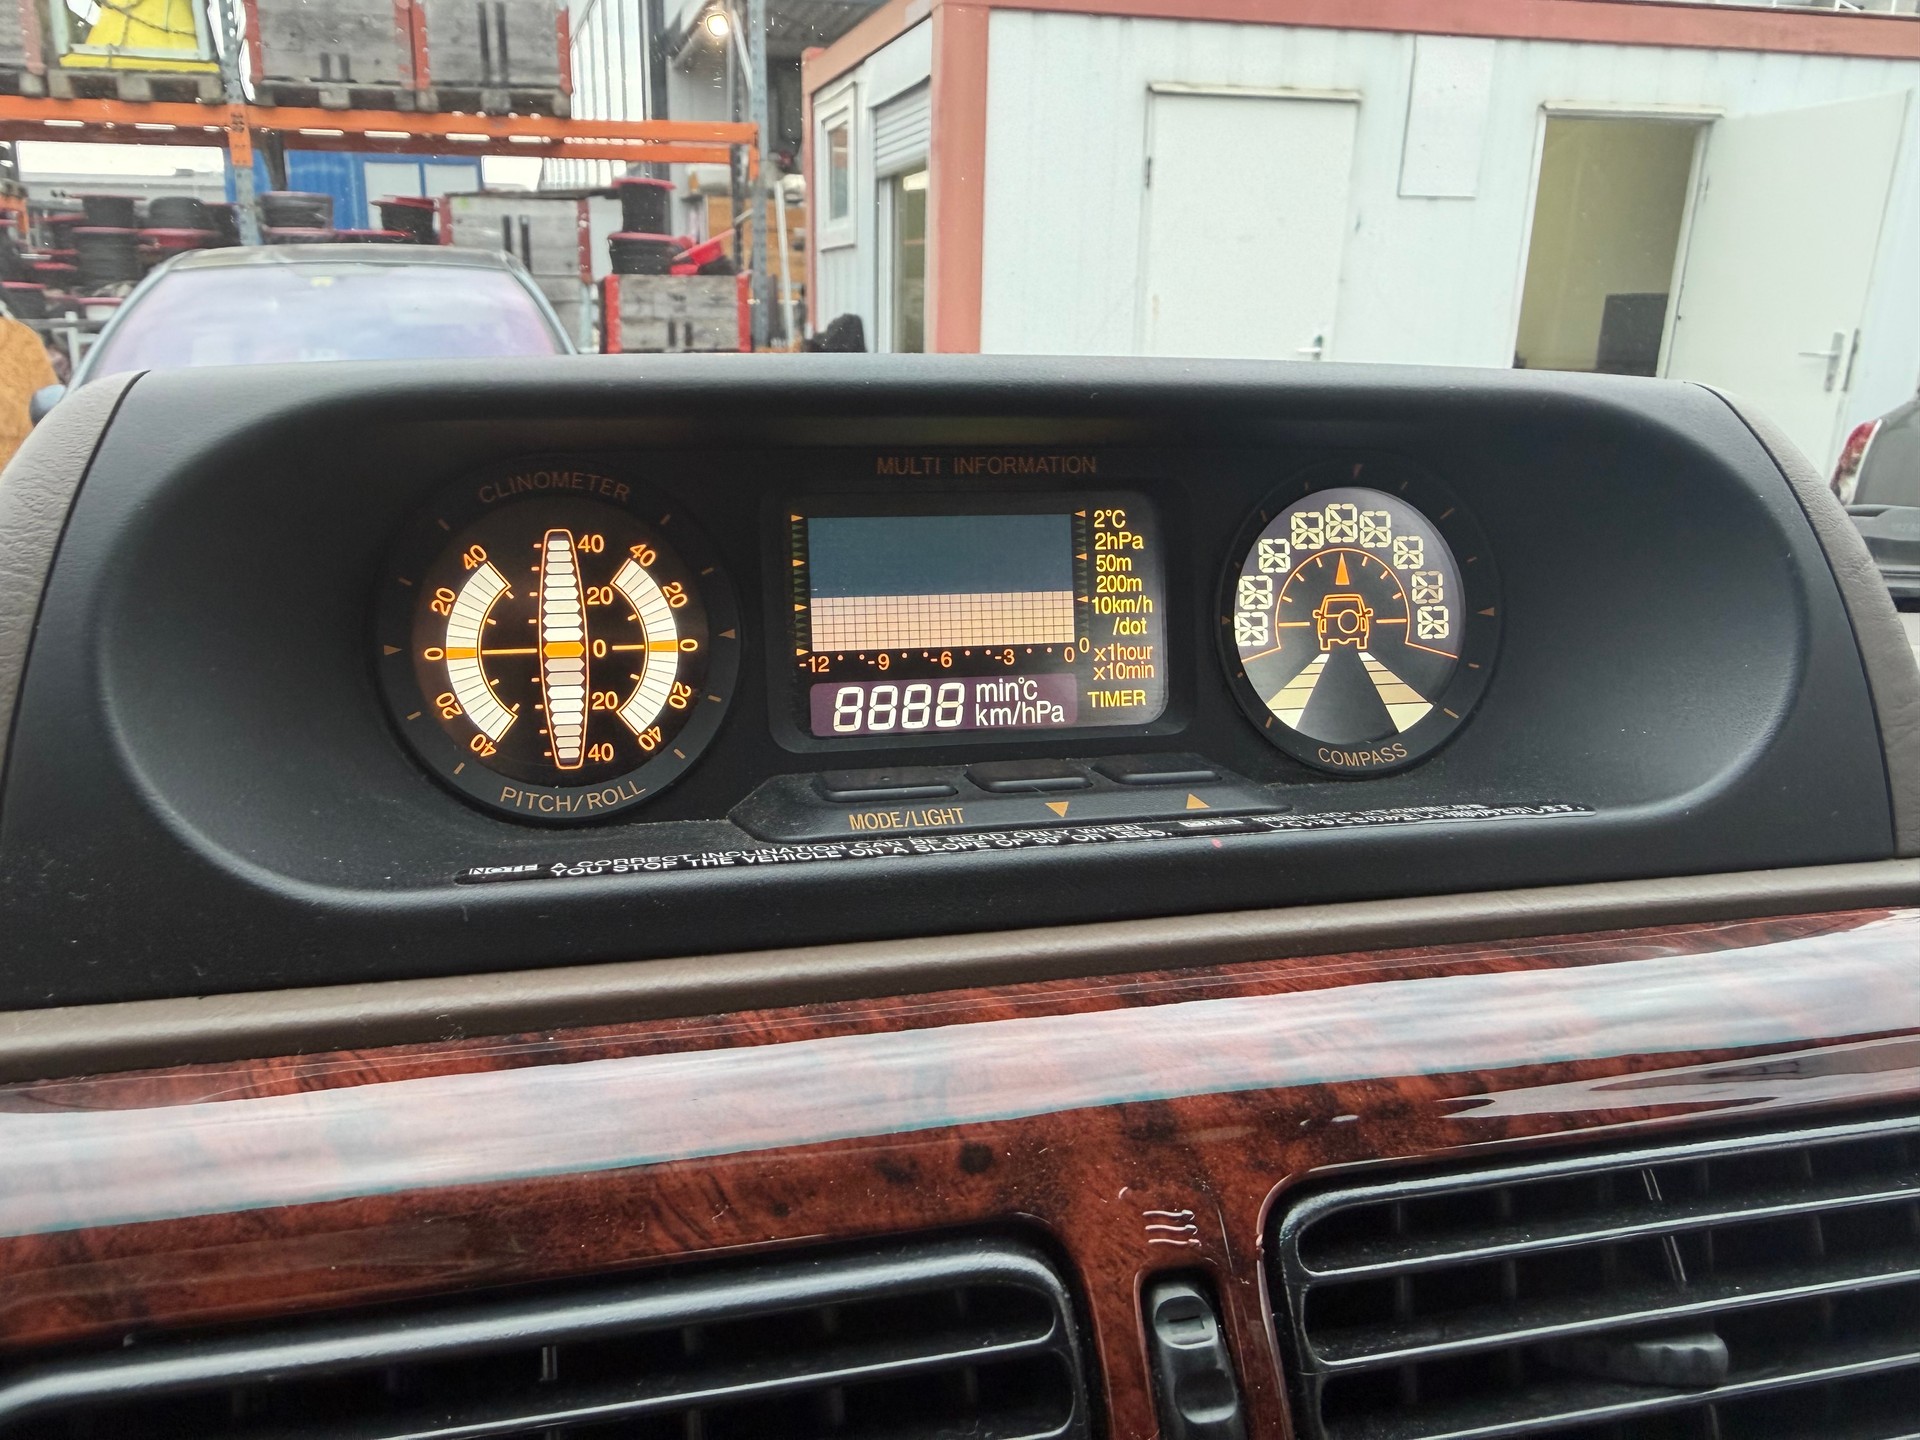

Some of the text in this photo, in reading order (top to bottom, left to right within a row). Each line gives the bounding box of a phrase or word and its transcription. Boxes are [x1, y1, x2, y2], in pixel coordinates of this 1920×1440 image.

[876, 455, 1097, 475] MULTI INFORMATION
[478, 470, 631, 503] CLINOMETER
[1093, 510, 1126, 529] 2°C
[577, 535, 605, 553] 40
[1094, 531, 1145, 551] 2hPa
[462, 544, 488, 572] 40
[628, 542, 657, 568] 40
[1095, 554, 1133, 572] 50m
[1096, 574, 1143, 593] 200m
[430, 587, 457, 617] 20
[586, 587, 614, 605] 20
[661, 580, 688, 609] 20
[1091, 594, 1154, 615] 10km/h
[1112, 616, 1148, 637] /dot
[423, 646, 445, 661] 0
[592, 638, 607, 657] 0
[678, 637, 699, 653] 0
[1078, 636, 1091, 654] 0
[1093, 642, 1154, 662] x1hour
[798, 646, 1076, 673] -12 -9 -6 -3 0
[1092, 661, 1156, 681] x10min
[434, 690, 464, 720] 20
[590, 691, 620, 711] 20
[667, 681, 692, 710] 20
[1087, 689, 1147, 708] TIMER
[975, 699, 1066, 727] km/hPa
[468, 732, 498, 760] 40
[636, 724, 664, 752] 40
[586, 742, 615, 763] 40
[1317, 743, 1408, 767] COMPASS
[500, 779, 646, 813] PITCH/ROLL
[848, 807, 966, 831] MODE/LIGHT
[550, 862, 568, 870] A
[577, 854, 692, 868] CORRECT
[702, 844, 846, 859] INCLINATION
[855, 839, 904, 849] CAN
[909, 837, 939, 846] BE
[946, 832, 1008, 843] READ
[1013, 828, 1071, 840] ONLY
[551, 866, 602, 877] YOU
[613, 861, 678, 873] STOP
[686, 856, 735, 868] THE
[741, 850, 843, 864] VEHICLE
[848, 847, 884, 858] ON
[892, 845, 910, 854] A
[916, 840, 990, 853] SLOPE
